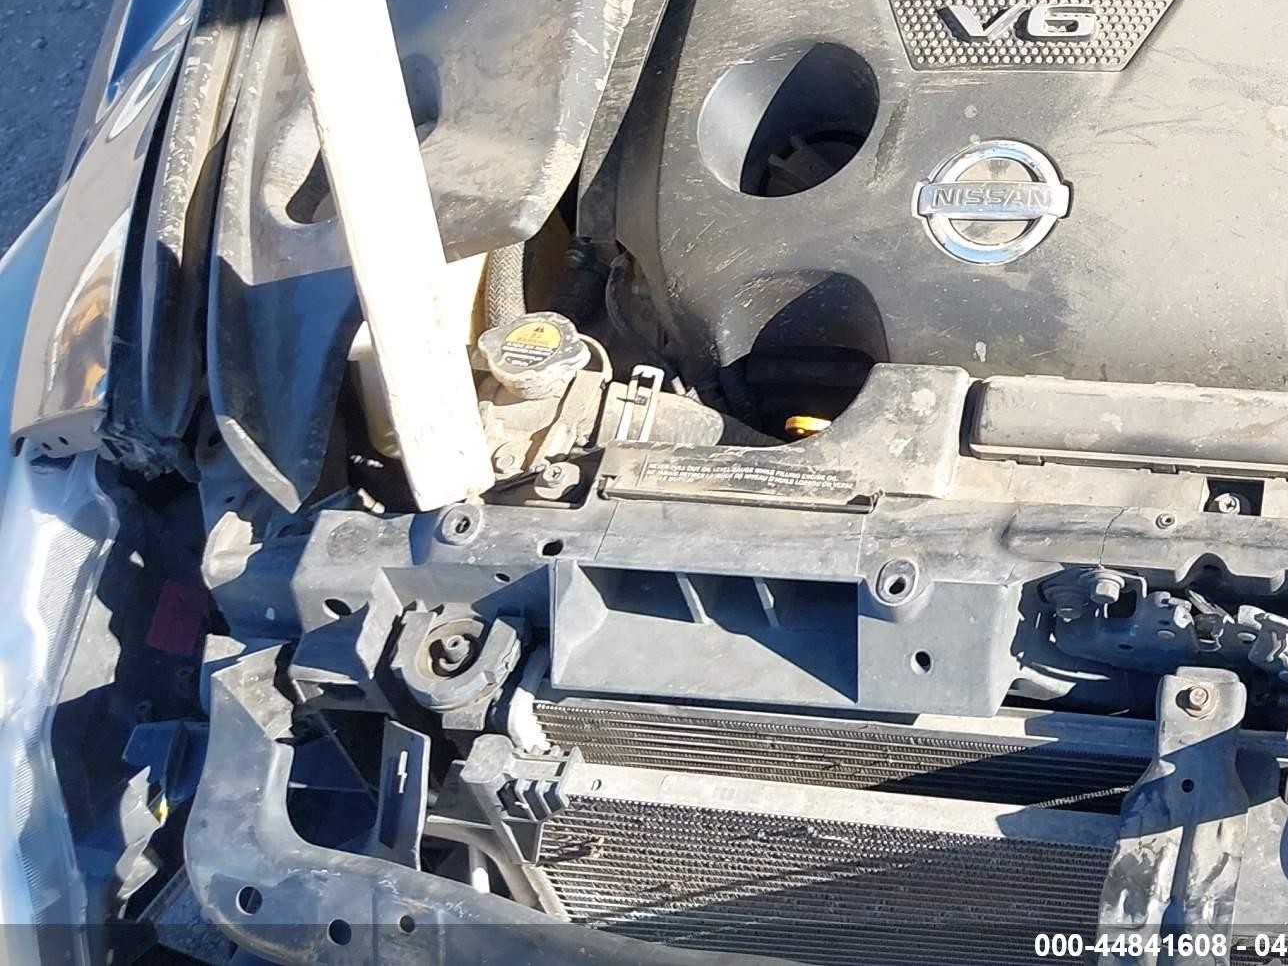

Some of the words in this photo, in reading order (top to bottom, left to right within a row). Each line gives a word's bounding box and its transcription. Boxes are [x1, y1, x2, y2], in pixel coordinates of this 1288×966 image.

[936, 4, 1097, 42] V6
[931, 186, 1052, 210] NISSAN
[775, 471, 800, 479] FILLING
